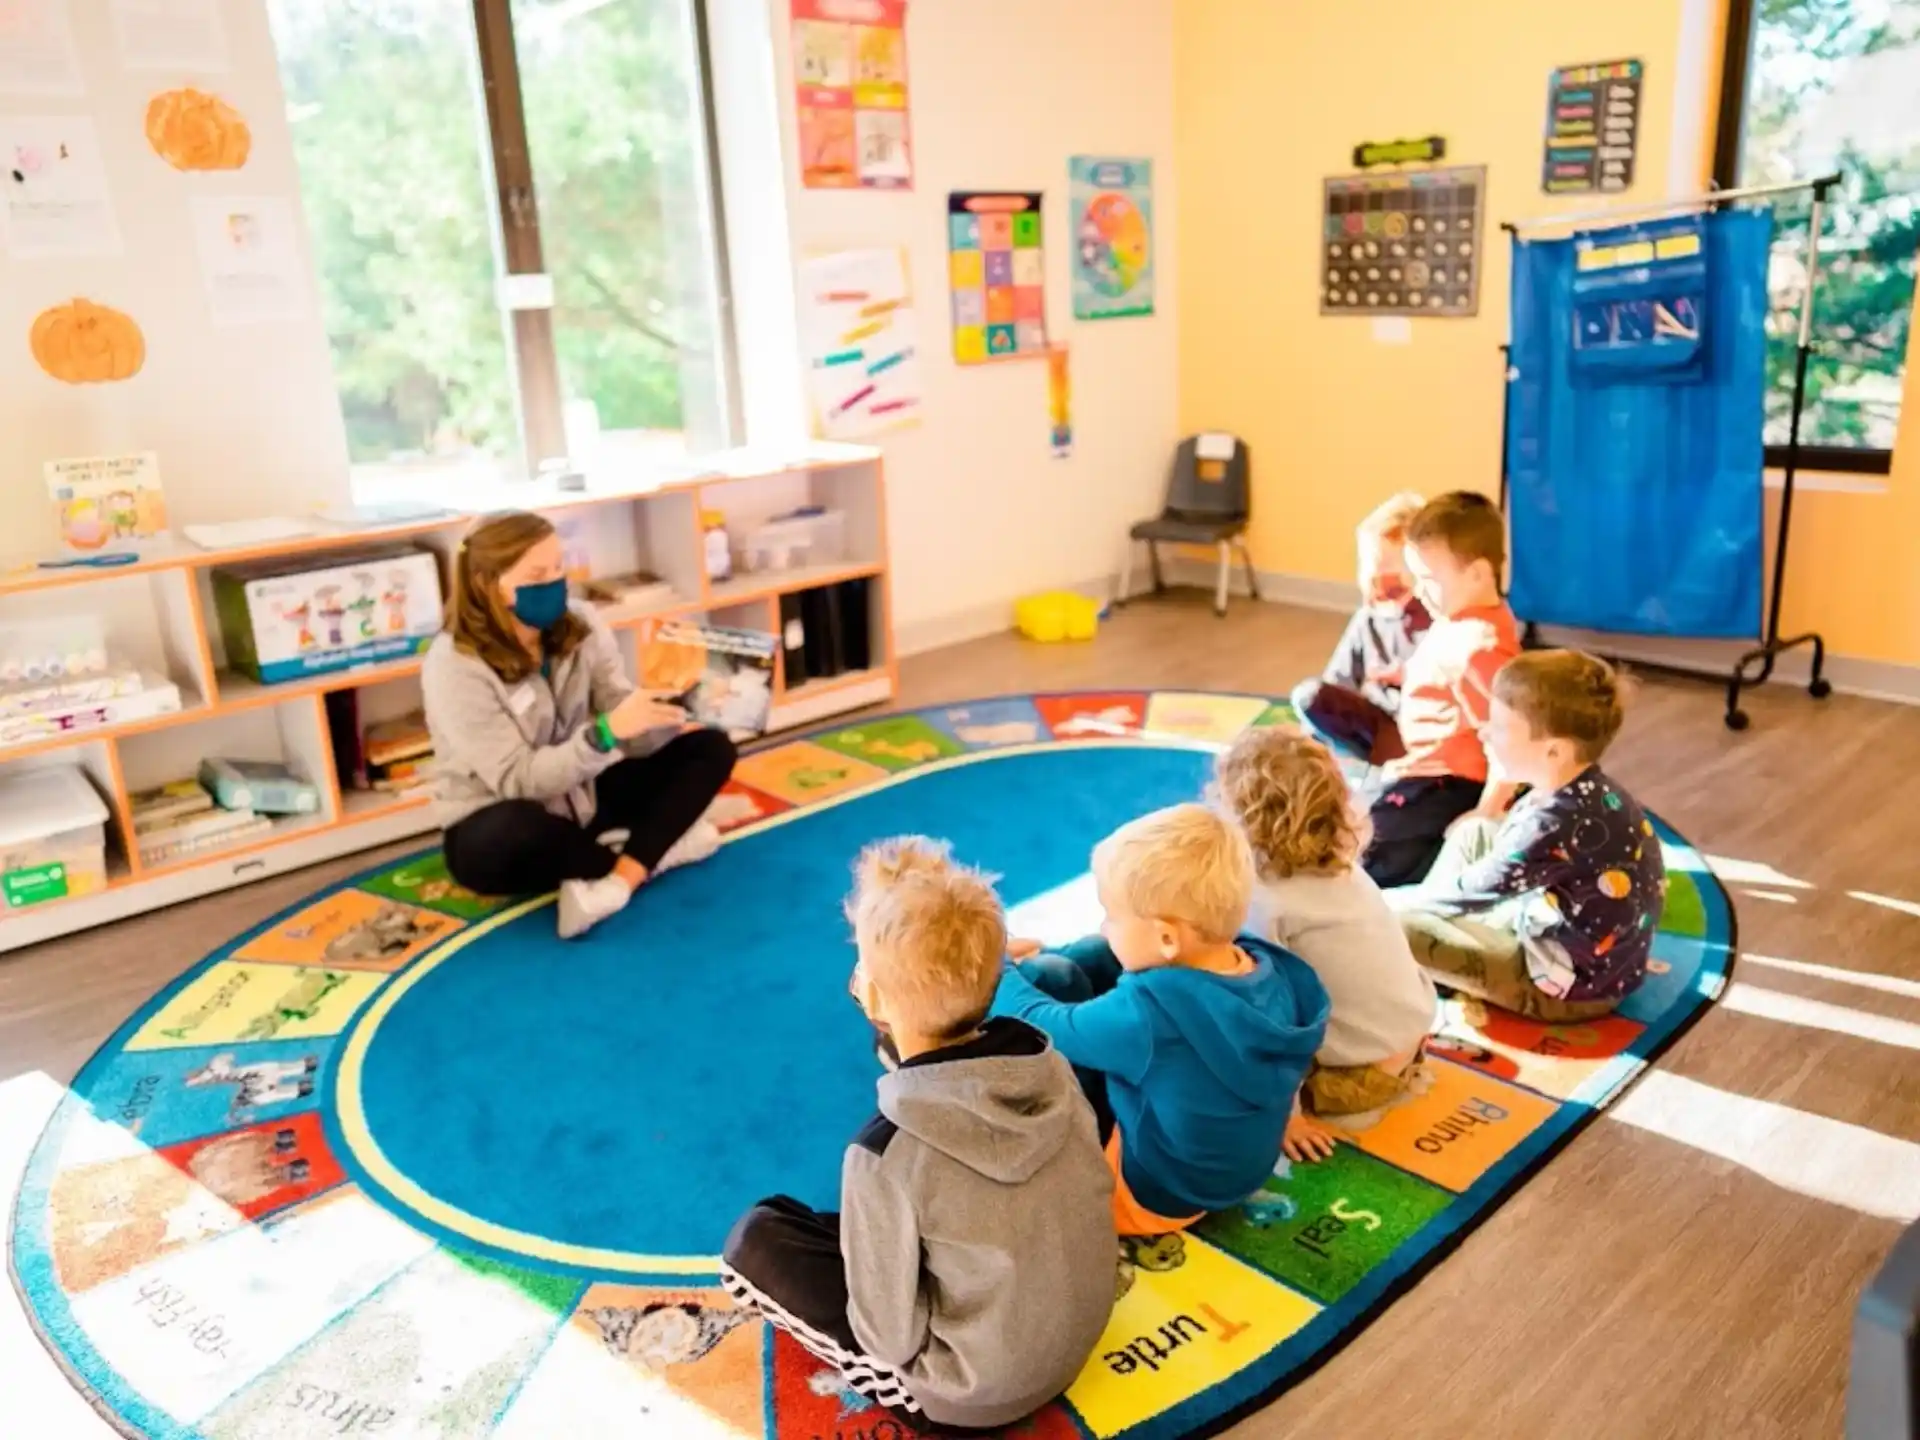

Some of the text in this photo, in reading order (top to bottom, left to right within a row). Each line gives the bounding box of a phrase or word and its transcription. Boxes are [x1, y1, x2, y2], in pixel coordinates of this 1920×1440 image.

[1414, 1096, 1509, 1154] Rhino
[1292, 1197, 1382, 1260] Seal
[1103, 1302, 1252, 1375] Turtle
[283, 1382, 396, 1434] alrus
